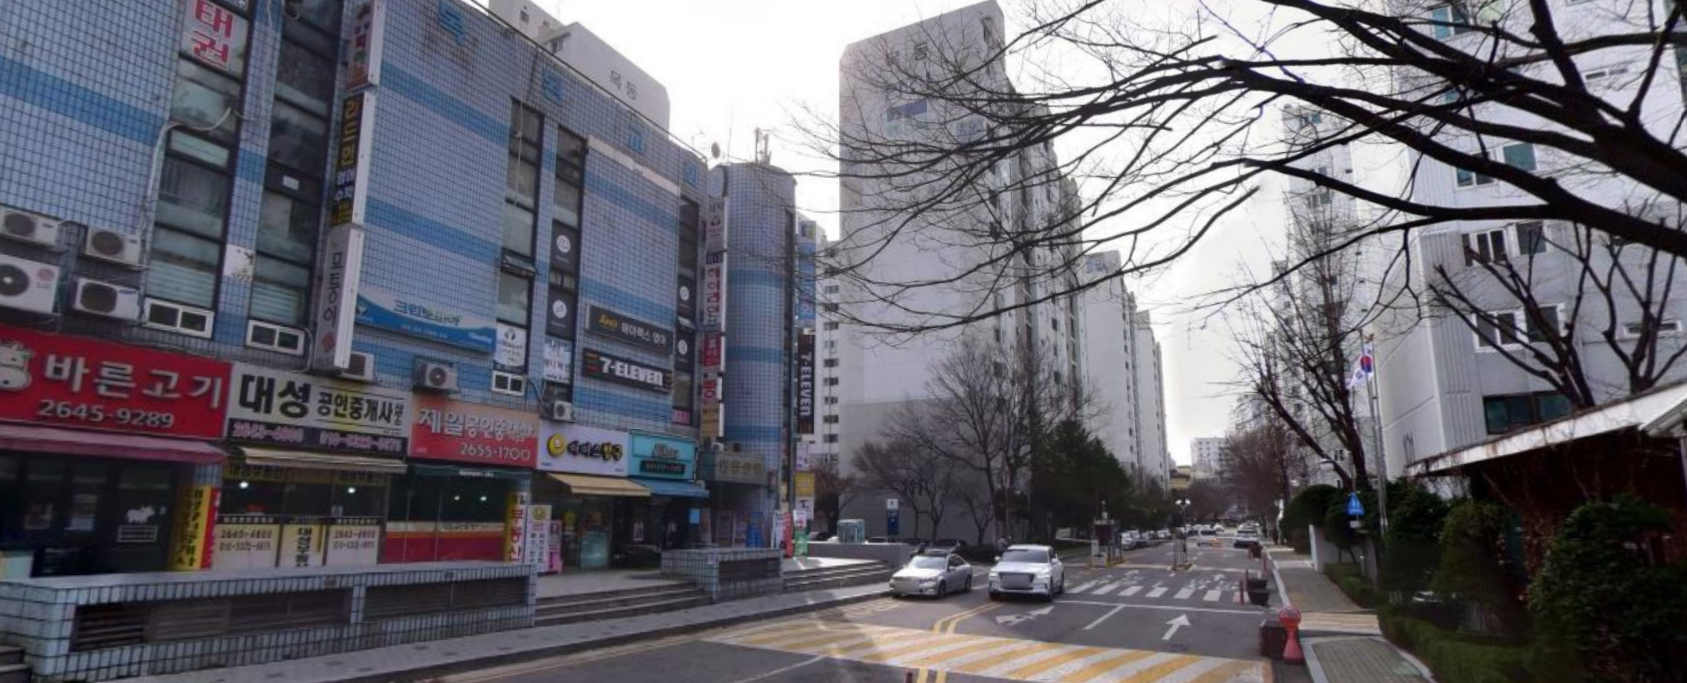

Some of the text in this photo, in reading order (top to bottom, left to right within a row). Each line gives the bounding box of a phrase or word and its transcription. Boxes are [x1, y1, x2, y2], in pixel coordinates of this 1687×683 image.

[193, 0, 234, 69] 태권
[609, 69, 639, 101] 목동
[45, 354, 223, 410] 바른고기
[239, 374, 312, 418] 대성
[37, 399, 175, 430] 2645-9289
[459, 441, 532, 461] 2655-1700
